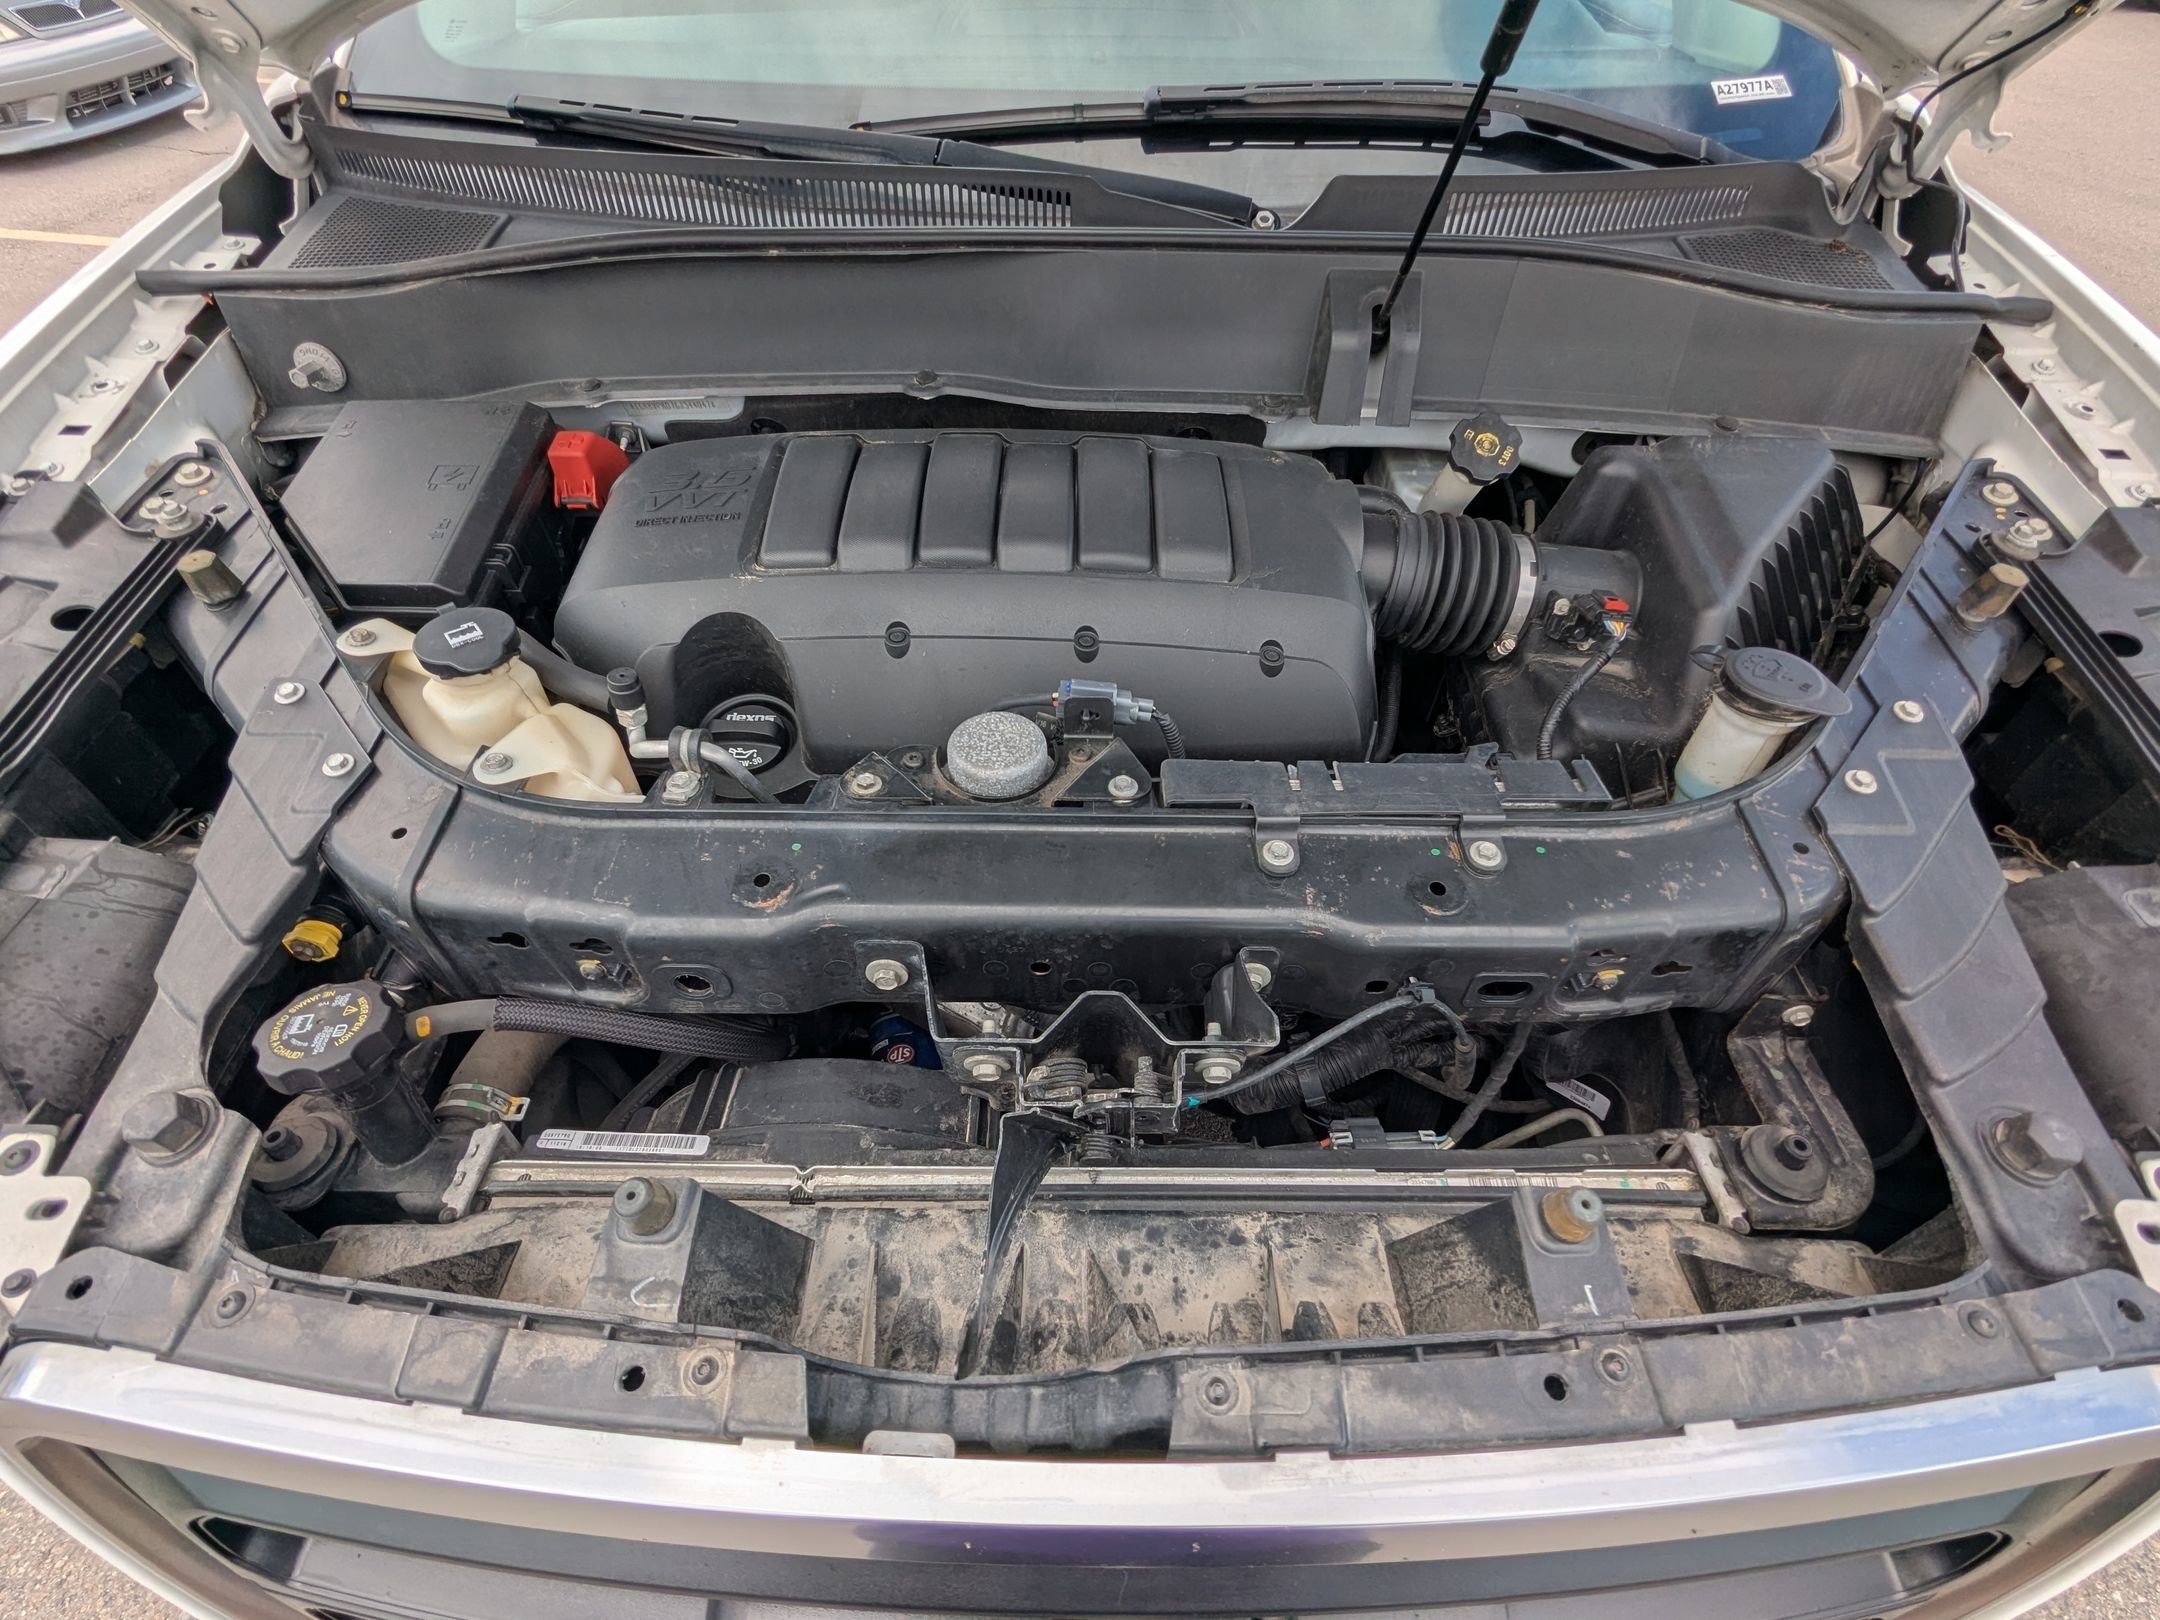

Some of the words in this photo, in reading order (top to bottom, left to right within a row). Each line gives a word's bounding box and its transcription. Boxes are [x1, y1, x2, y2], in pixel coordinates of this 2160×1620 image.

[1717, 80, 1774, 95] A27977A
[680, 512, 742, 524] INJECTION
[890, 1047, 911, 1063] STP
